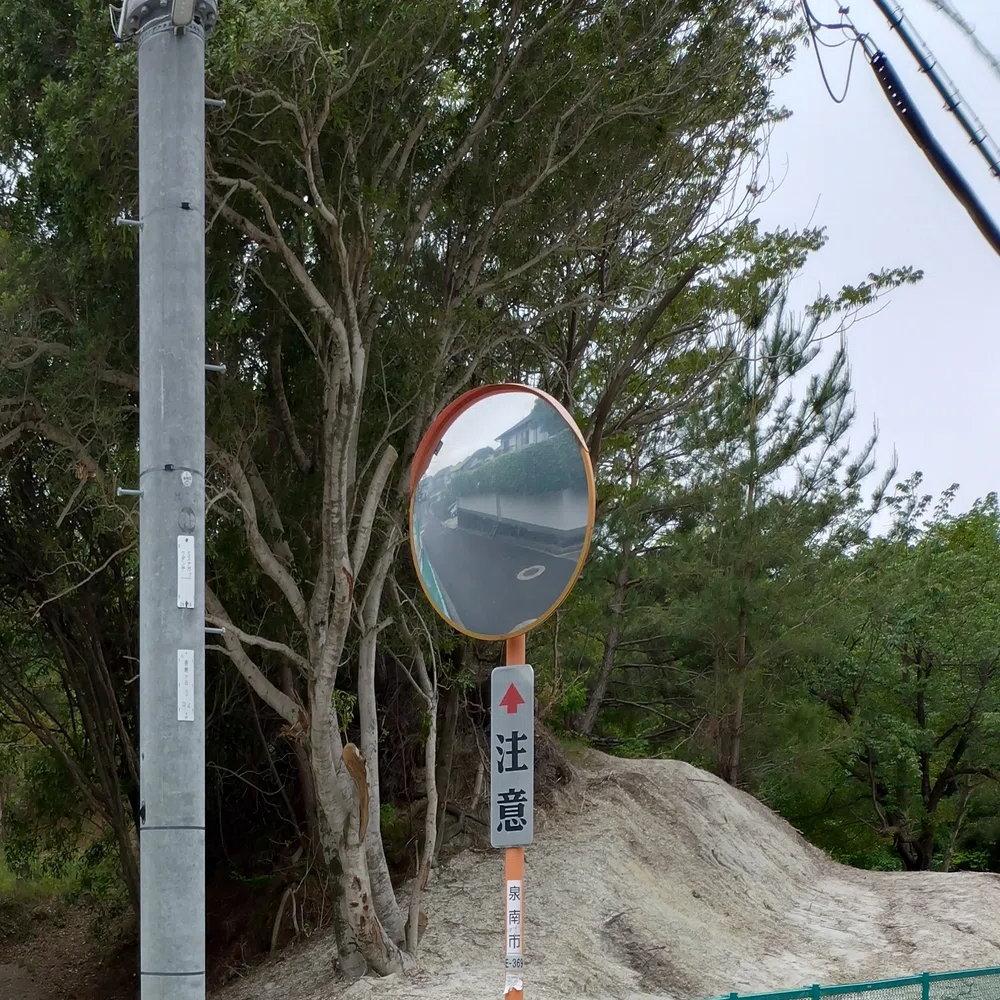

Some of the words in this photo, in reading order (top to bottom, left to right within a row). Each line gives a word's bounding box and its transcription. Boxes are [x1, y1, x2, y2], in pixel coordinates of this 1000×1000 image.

[496, 730, 528, 833] 注意
[508, 885, 520, 949] 泉南市
